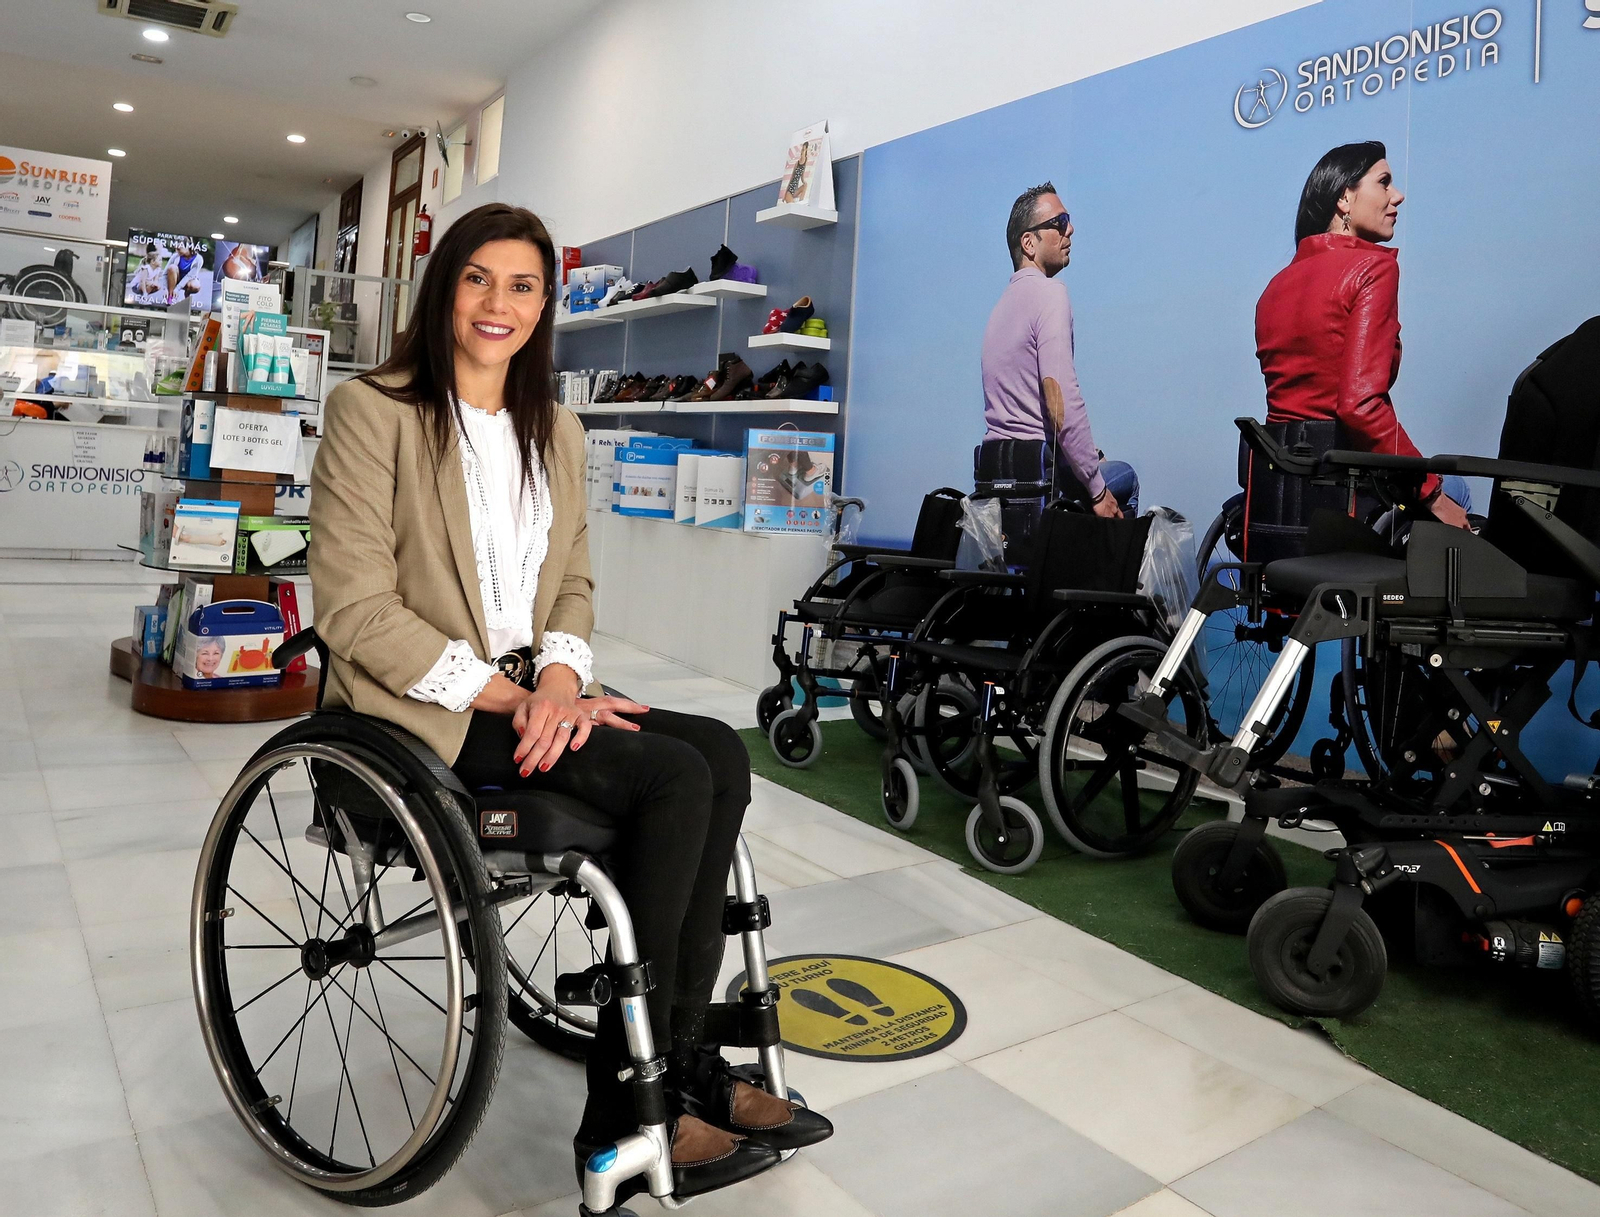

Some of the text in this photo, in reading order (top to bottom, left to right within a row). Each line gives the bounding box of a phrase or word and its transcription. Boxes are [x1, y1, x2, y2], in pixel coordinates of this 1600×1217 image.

[1296, 8, 1503, 89] SANDIONISIO
[1294, 42, 1499, 113] ORTOPEDIA
[19, 161, 98, 186] SUNRISE
[34, 195, 51, 204] JAY
[170, 240, 208, 252] MAMÁS
[238, 422, 269, 432] OFERTA
[222, 434, 240, 442] LOTE
[247, 436, 269, 445] BOTES
[244, 448, 254, 456] 5€
[31, 464, 145, 483] SANDIONISIO
[28, 480, 143, 496] ORTOPEDIA
[489, 813, 508, 824] JAY
[788, 968, 834, 985] TURNO
[822, 1003, 947, 1049] MANTENGA LA DISTANCIA
[878, 1029, 896, 1039] DE
[893, 1011, 948, 1033] SEGURIDAD
[888, 1026, 931, 1044] METROS
[893, 1032, 938, 1051] GRACIAS
